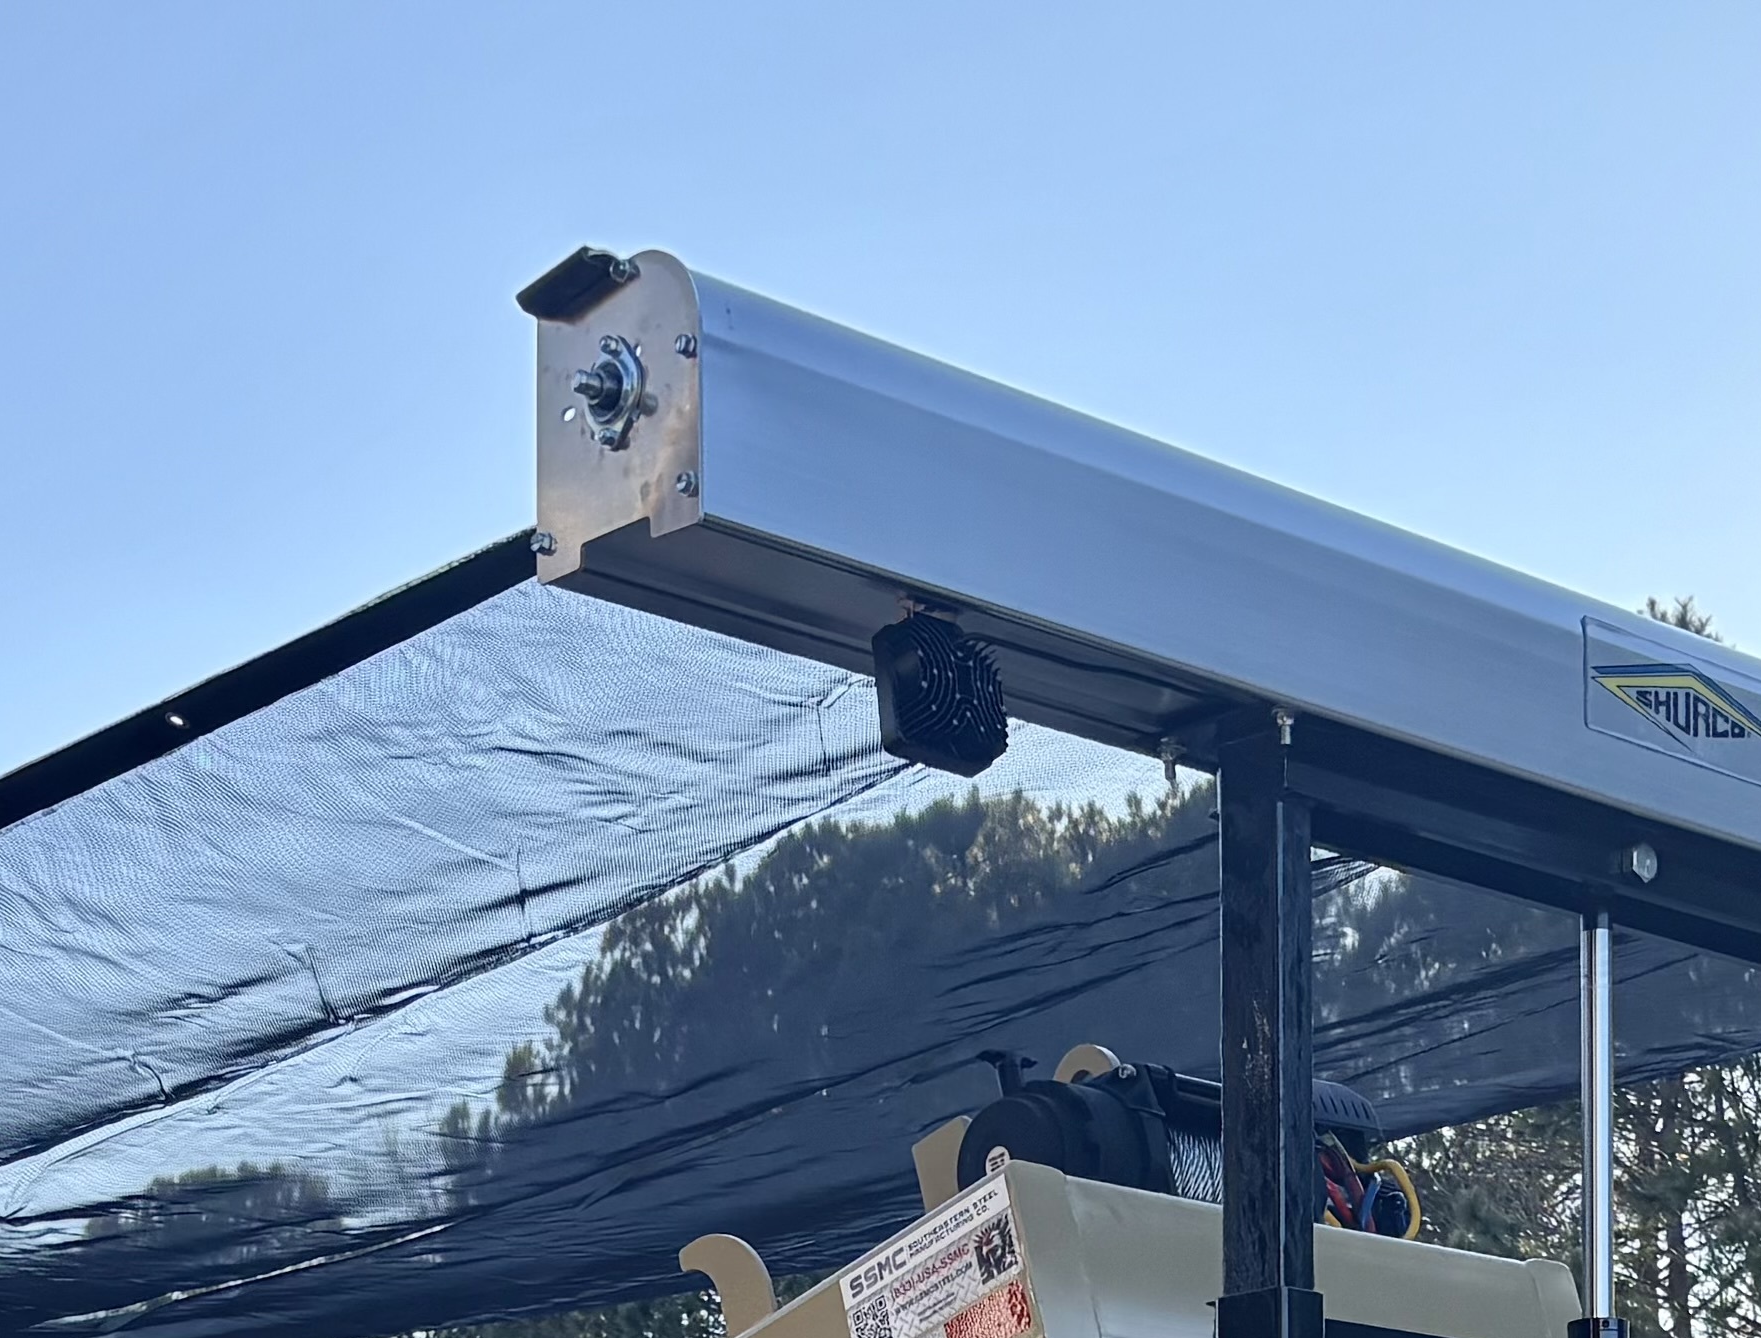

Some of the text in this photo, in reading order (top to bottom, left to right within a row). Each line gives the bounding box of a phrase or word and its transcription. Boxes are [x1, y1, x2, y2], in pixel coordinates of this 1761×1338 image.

[908, 1189, 999, 1251] SOUTHEASTERN STEEL
[849, 1246, 907, 1298] SSMC
